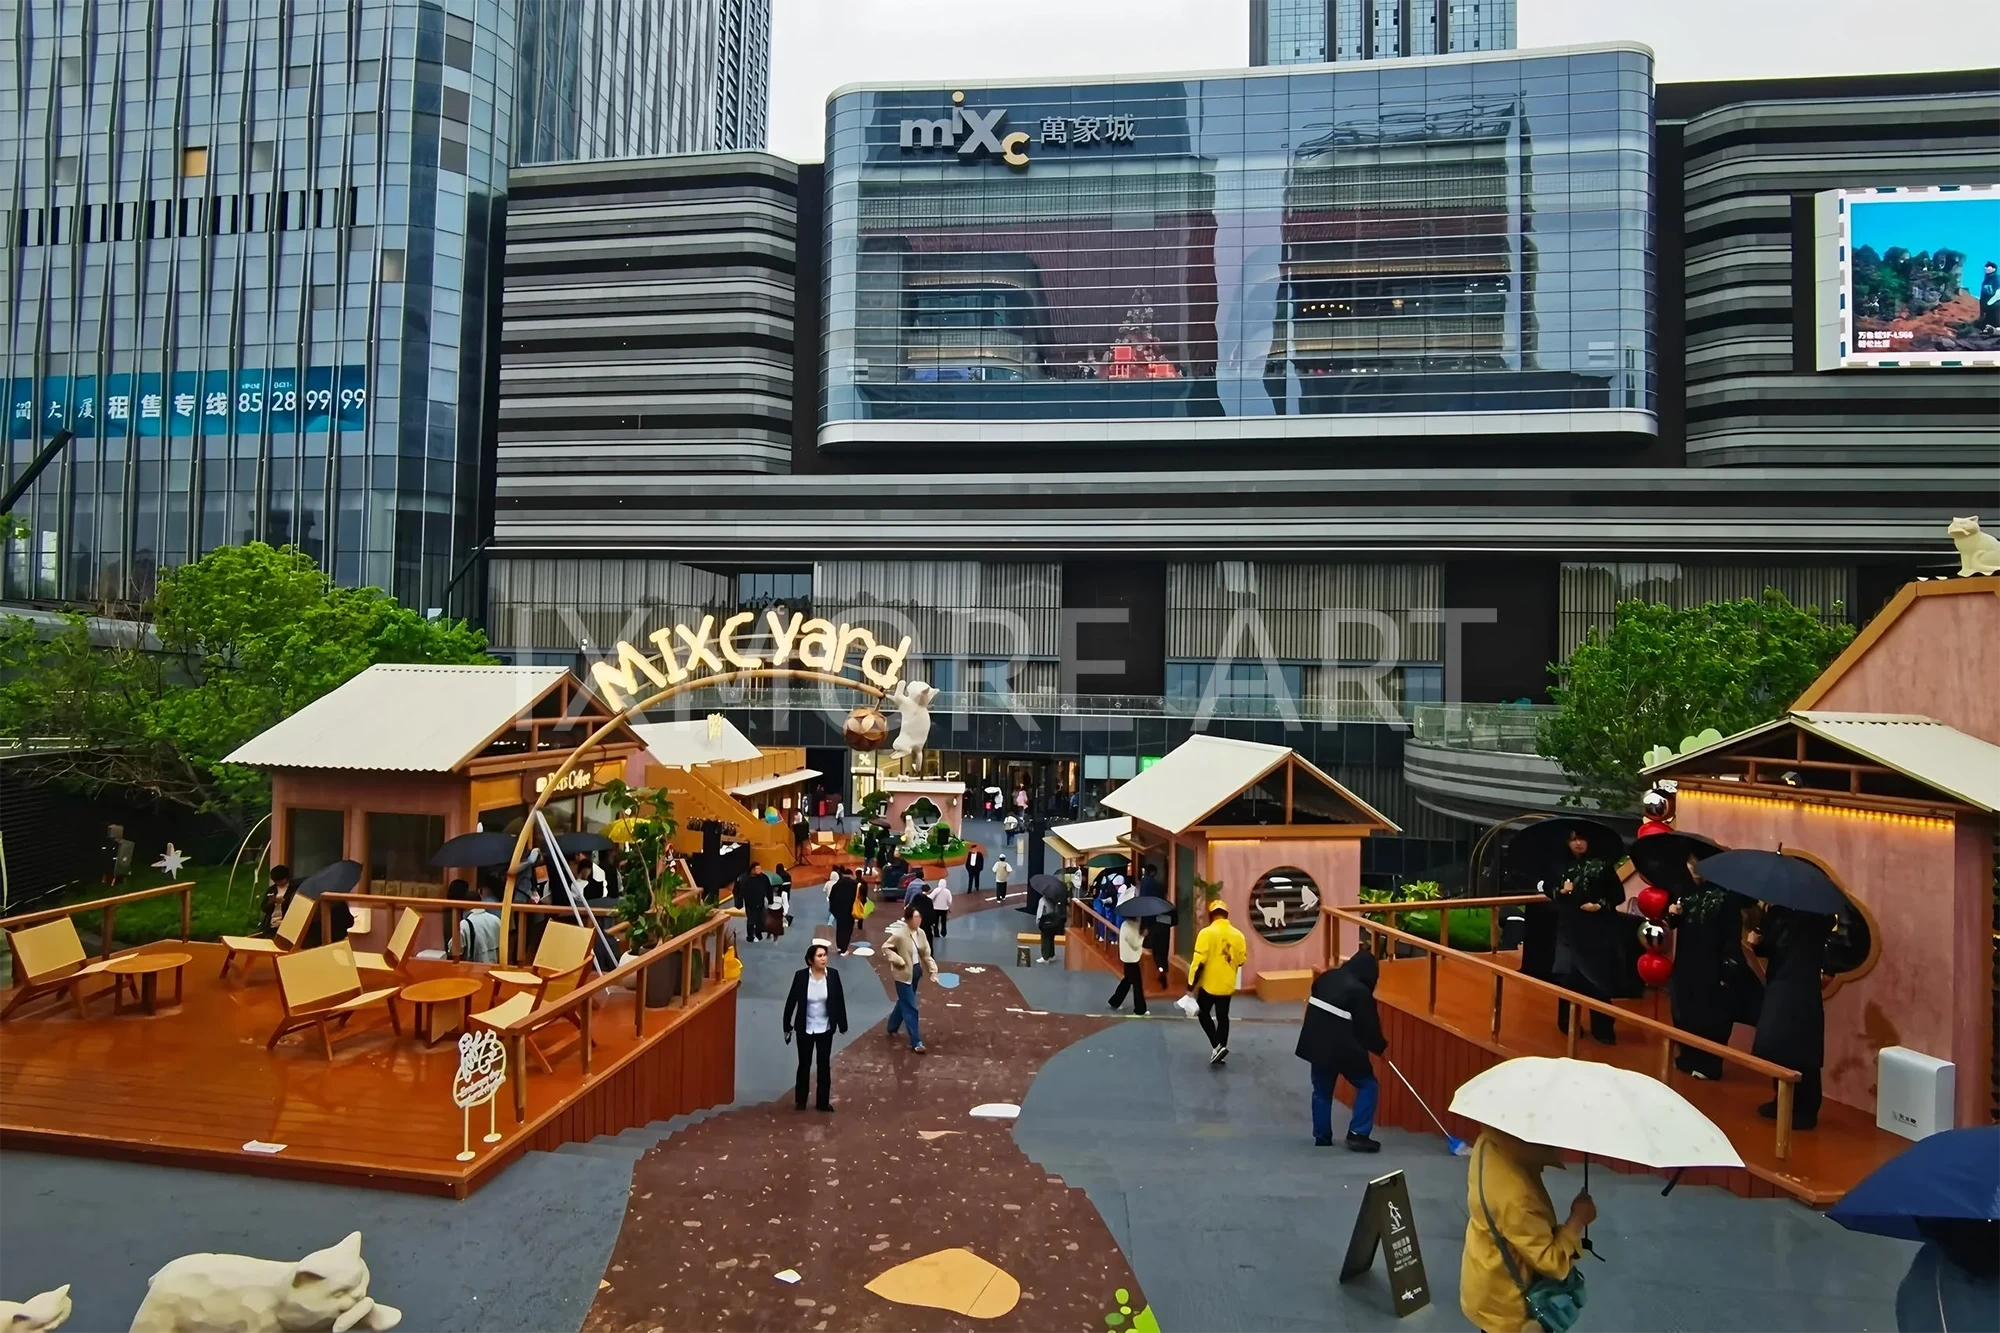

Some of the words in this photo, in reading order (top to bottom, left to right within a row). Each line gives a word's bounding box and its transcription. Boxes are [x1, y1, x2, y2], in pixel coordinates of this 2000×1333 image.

[1040, 114, 1136, 145] 萬象城
[108, 392, 228, 419] 租售专线
